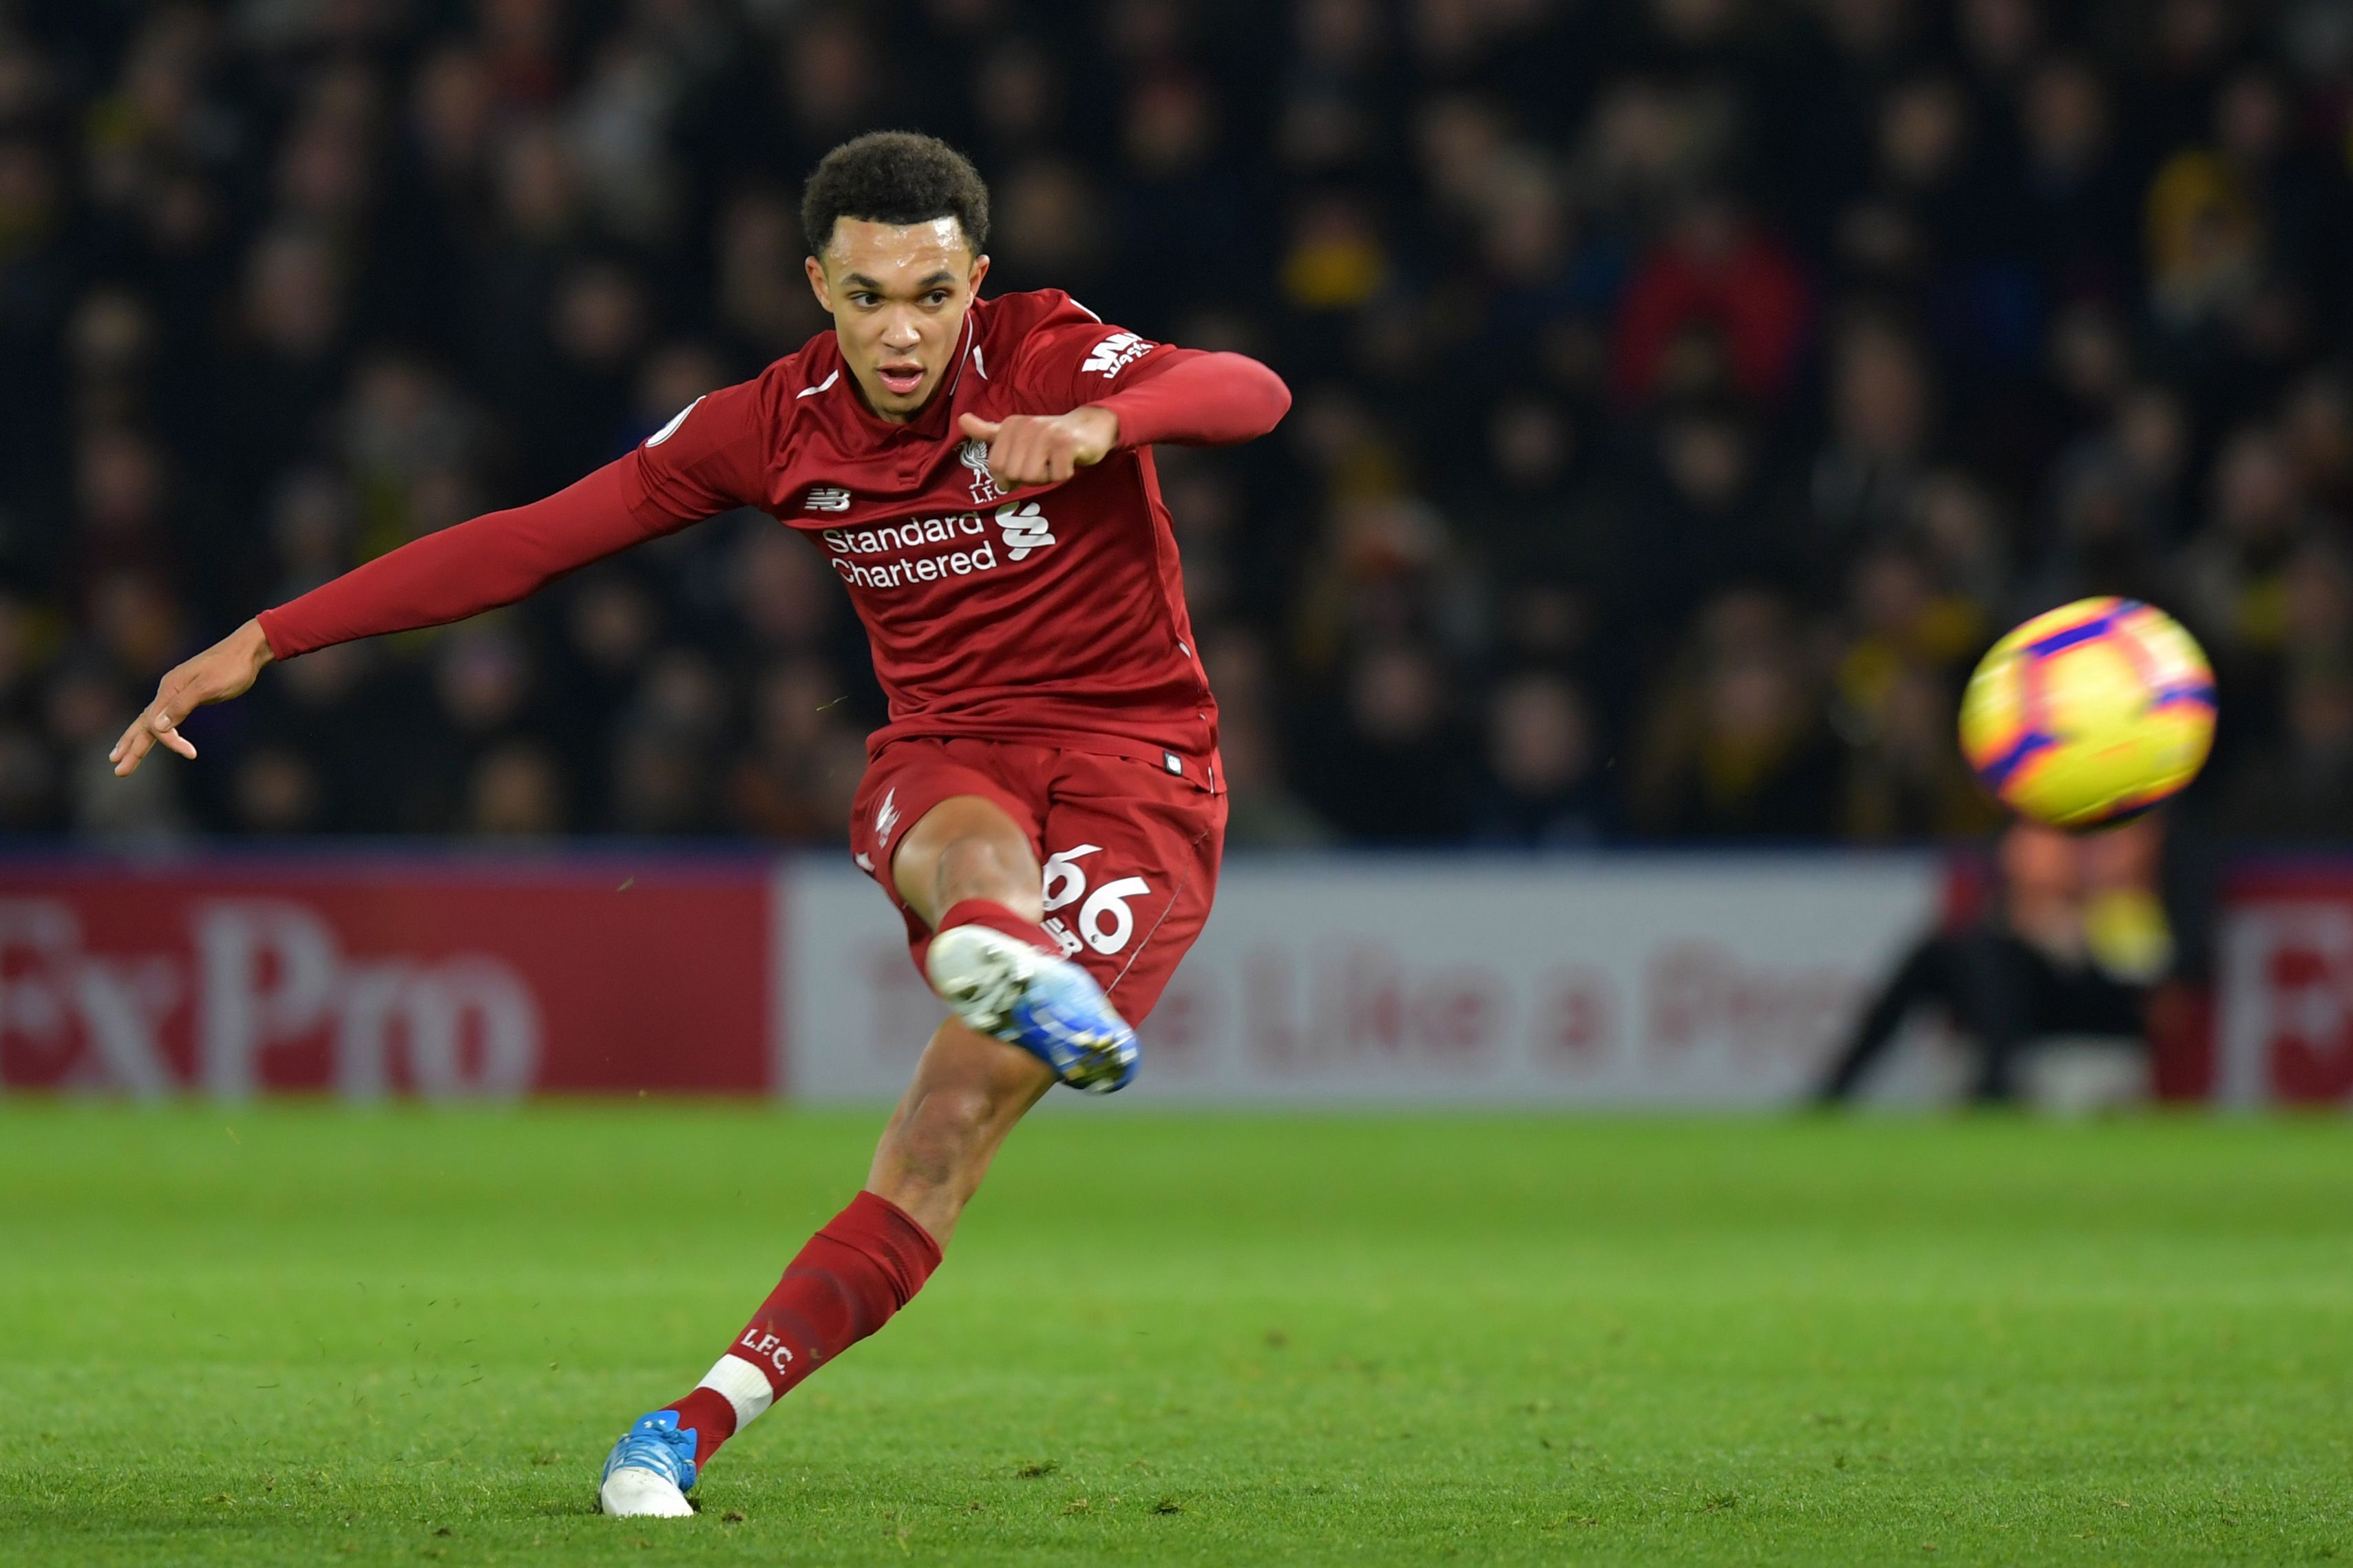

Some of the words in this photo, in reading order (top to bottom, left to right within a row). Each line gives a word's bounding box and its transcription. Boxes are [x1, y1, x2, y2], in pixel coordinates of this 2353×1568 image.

[822, 510, 985, 554] Standard
[832, 540, 998, 588] Chartered
[1042, 843, 1152, 955] 66
[740, 1328, 793, 1376] L.F.C.
